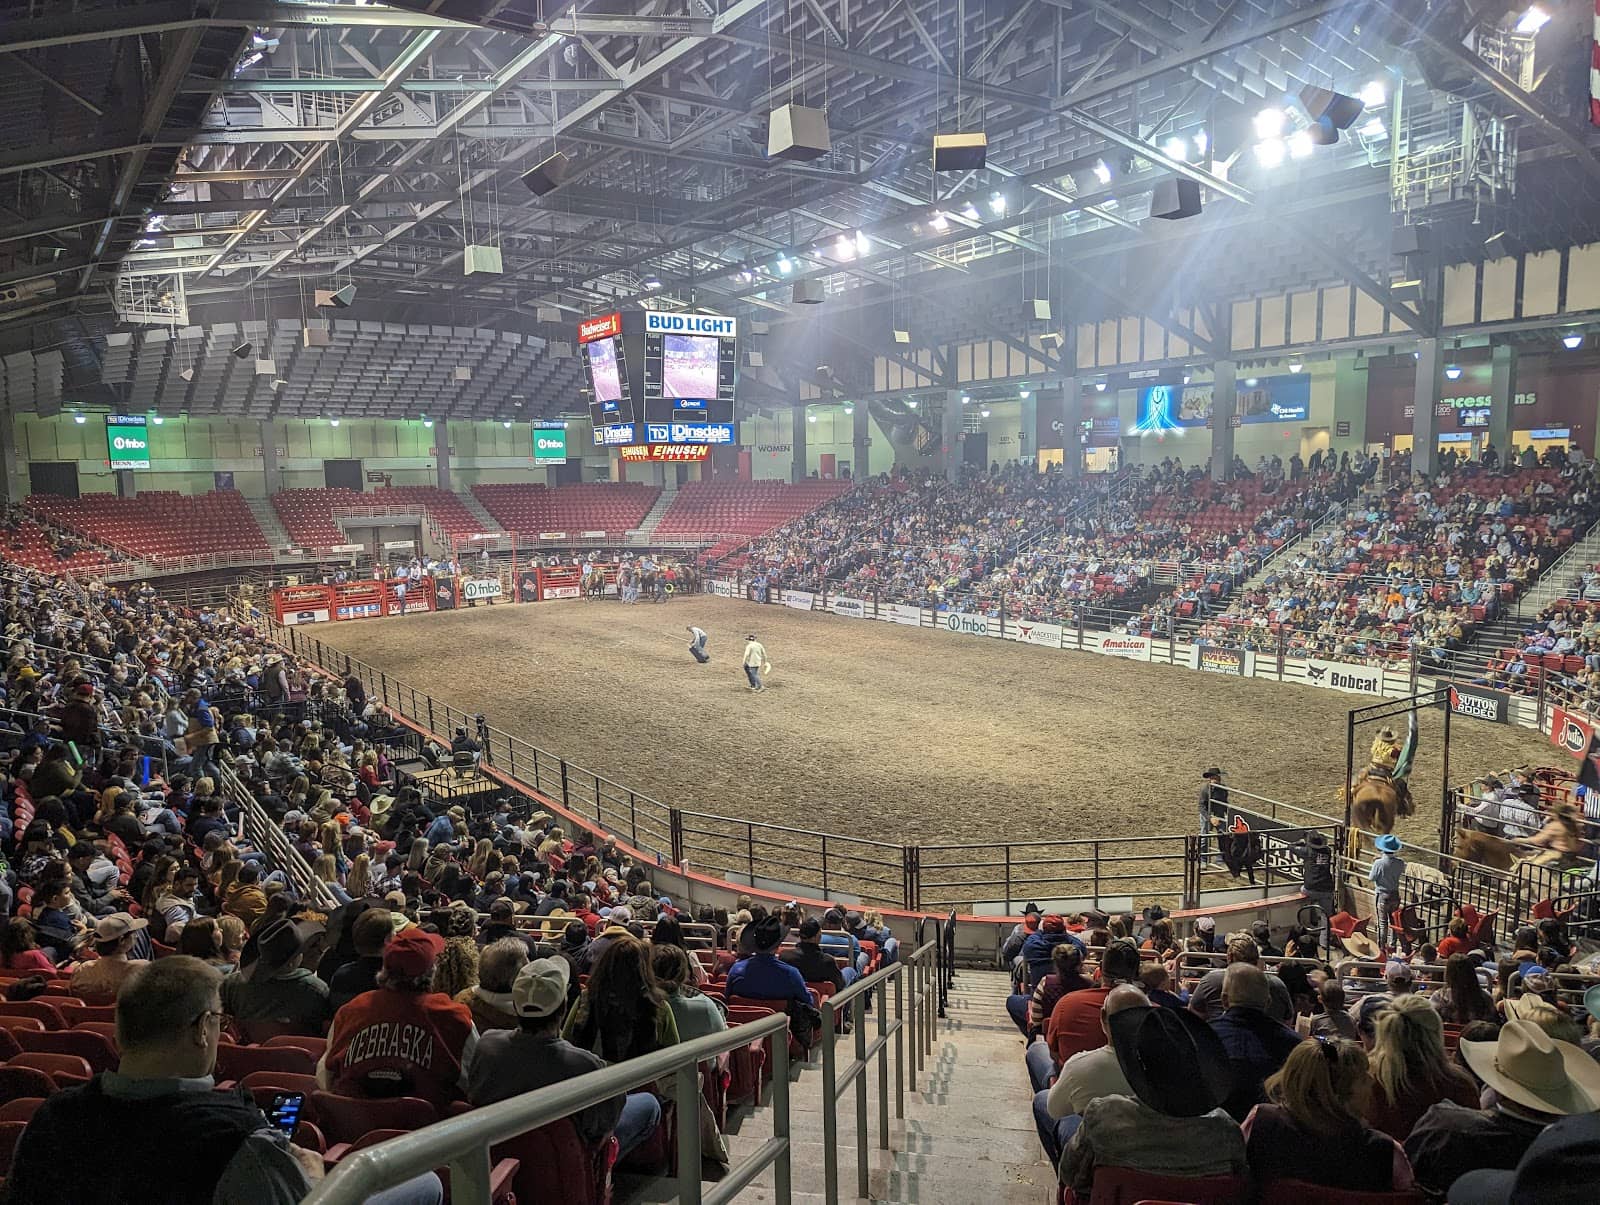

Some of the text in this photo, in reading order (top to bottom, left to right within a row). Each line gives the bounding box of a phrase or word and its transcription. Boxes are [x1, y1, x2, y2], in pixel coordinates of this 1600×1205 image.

[581, 320, 610, 336] Budweiser
[649, 315, 733, 333] BUD LIGHT
[677, 425, 730, 438] Dinsdale
[125, 439, 145, 448] fnbo
[653, 445, 708, 456] EIHUSEN
[479, 583, 501, 596] fnbo
[962, 617, 986, 633] fnbo
[1103, 639, 1145, 649] American
[1330, 672, 1378, 692] Bobcat
[1458, 695, 1497, 711] SUTTON
[1457, 705, 1496, 719] RODEO
[1559, 717, 1585, 750] Justin
[344, 1023, 433, 1069] NEBRASKA
